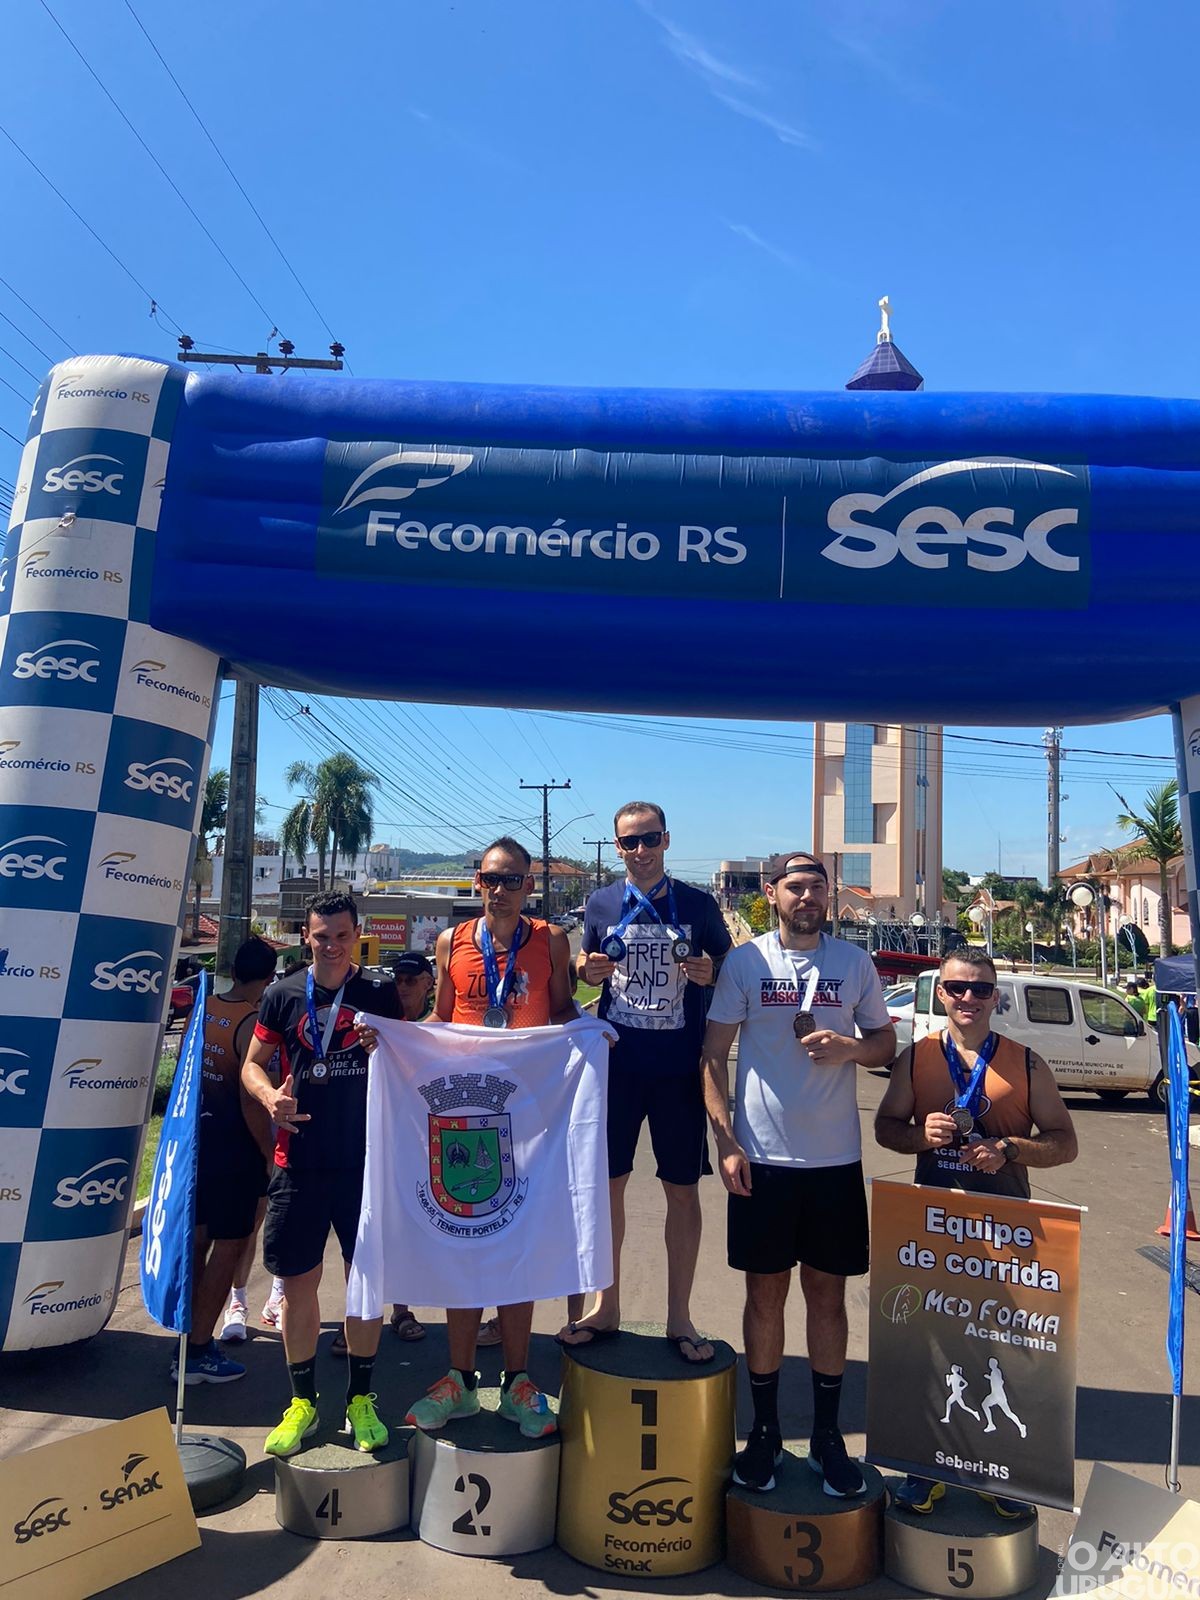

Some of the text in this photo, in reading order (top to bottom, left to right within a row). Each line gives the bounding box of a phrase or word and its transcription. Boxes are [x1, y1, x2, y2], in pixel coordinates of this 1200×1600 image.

[57, 387, 151, 403] Fecomércio RS
[42, 467, 124, 495] Sesc
[365, 510, 747, 565] Fecomércio RS
[820, 492, 1080, 572] Sesc
[25, 566, 123, 584] Fecomércio RS
[12, 652, 100, 683] Sesc
[136, 674, 211, 709] Fecomércio RS
[0, 758, 96, 775] ecomércio RS
[123, 763, 193, 802] Sesc
[0, 853, 67, 881] esc
[105, 867, 182, 892] Fecomércio RS
[39, 966, 61, 979] RS
[626, 943, 670, 976] FREE
[90, 962, 162, 994] Sesc
[625, 965, 669, 992] AND
[761, 980, 844, 992] MIAMI EAT
[626, 990, 670, 1011] WILD
[204, 1042, 225, 1055] ede
[1048, 1059, 1083, 1067] PREFEITURA
[69, 1076, 138, 1089] Fecomércio
[203, 1070, 224, 1082] orma
[937, 1160, 973, 1172] SEBERI
[0, 1188, 22, 1201] RS
[52, 1176, 128, 1208] Sesc
[437, 1218, 471, 1236] TENENTE
[472, 1217, 509, 1236] PORTELA
[512, 1193, 524, 1207] RS
[925, 1205, 1033, 1249] Equipe
[898, 1241, 1061, 1292] de corrida
[31, 1293, 102, 1315] Fecomércio
[964, 1322, 1057, 1352] Academia
[630, 1389, 658, 1471] 1
[935, 1450, 1010, 1481] Seberi-RS
[100, 1471, 163, 1510] Senac
[452, 1472, 491, 1537] 2
[315, 1488, 343, 1526] 4
[606, 1492, 694, 1526] Sesc
[14, 1507, 71, 1543] Sesc
[604, 1534, 692, 1553] Fecomércio
[783, 1521, 824, 1586] 3
[604, 1553, 652, 1572] Senac
[947, 1547, 974, 1588] 5
